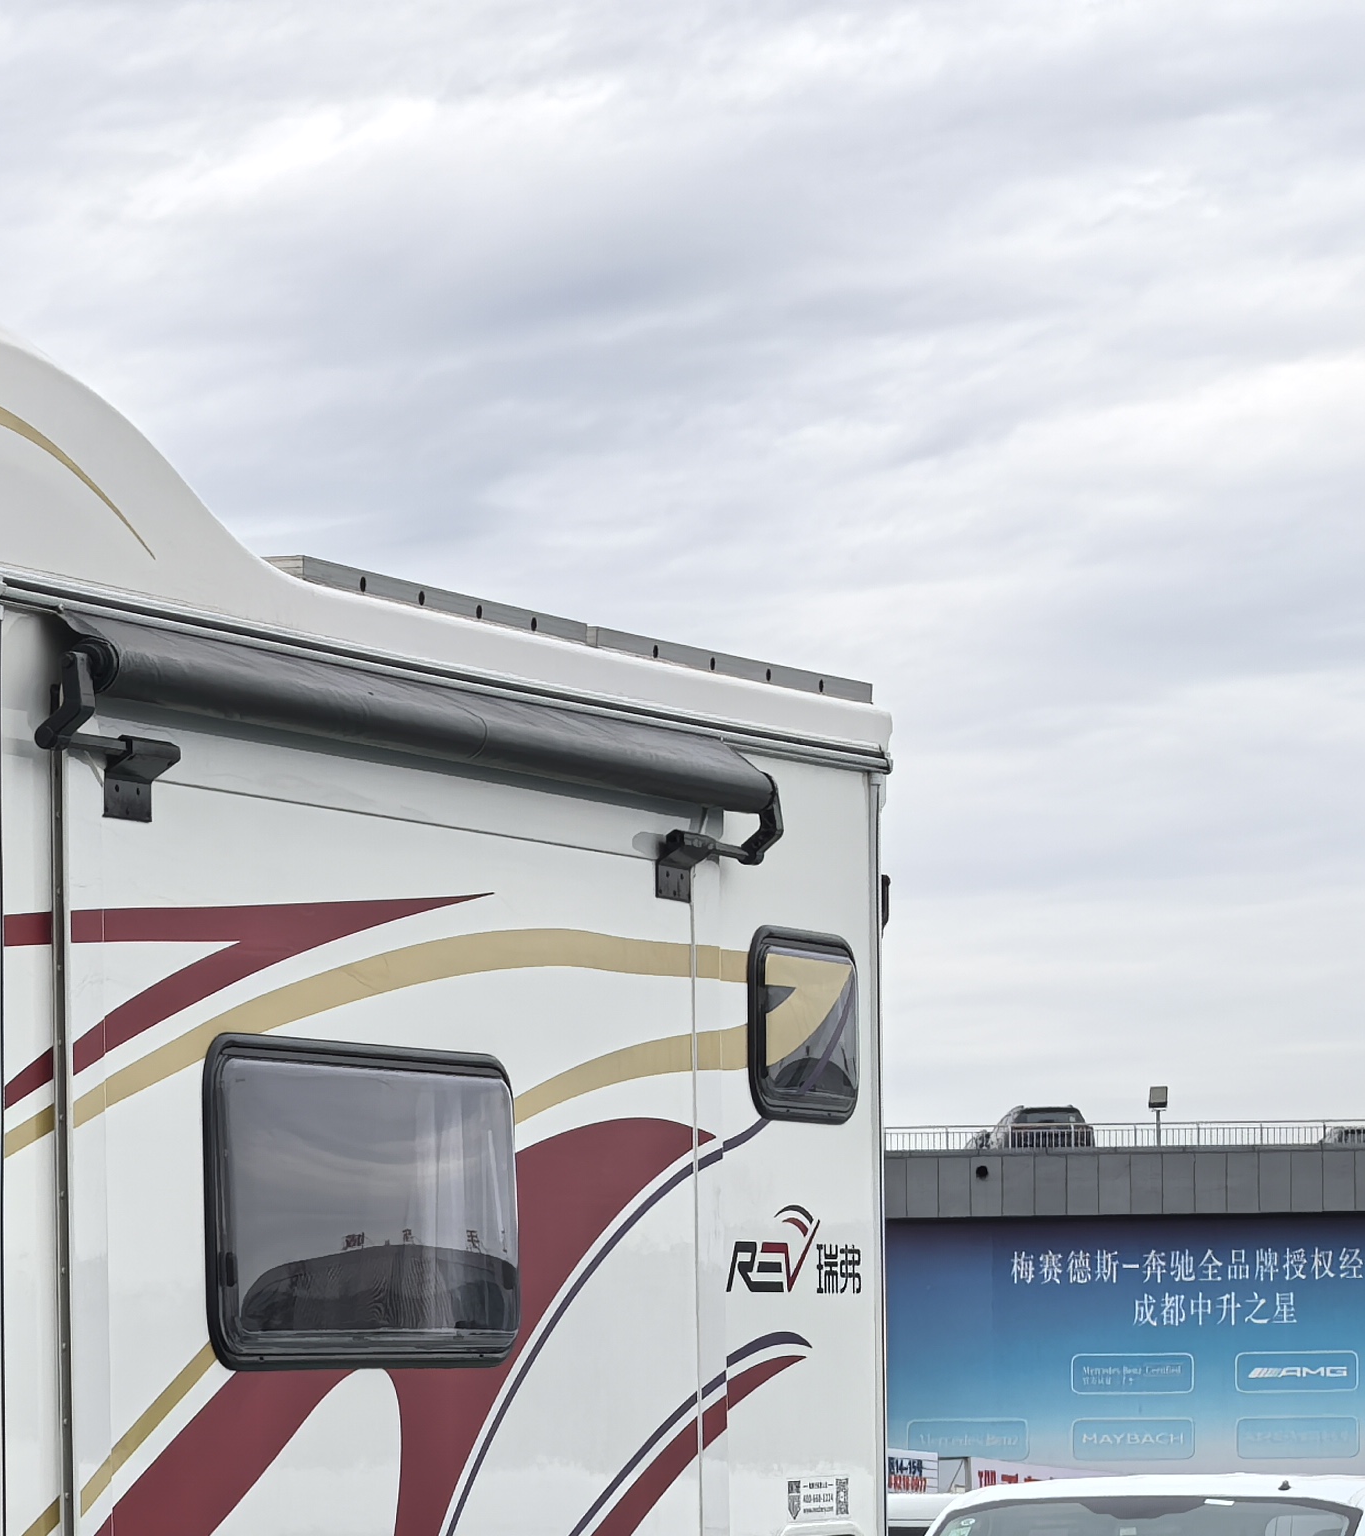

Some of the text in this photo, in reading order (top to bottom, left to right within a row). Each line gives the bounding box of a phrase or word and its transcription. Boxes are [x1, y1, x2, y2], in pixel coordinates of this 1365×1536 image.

[726, 1205, 820, 1293] REV
[1132, 1292, 1298, 1327] 成都中升之星
[1278, 1366, 1349, 1378] AMG
[1082, 1432, 1184, 1446] MAYBACH
